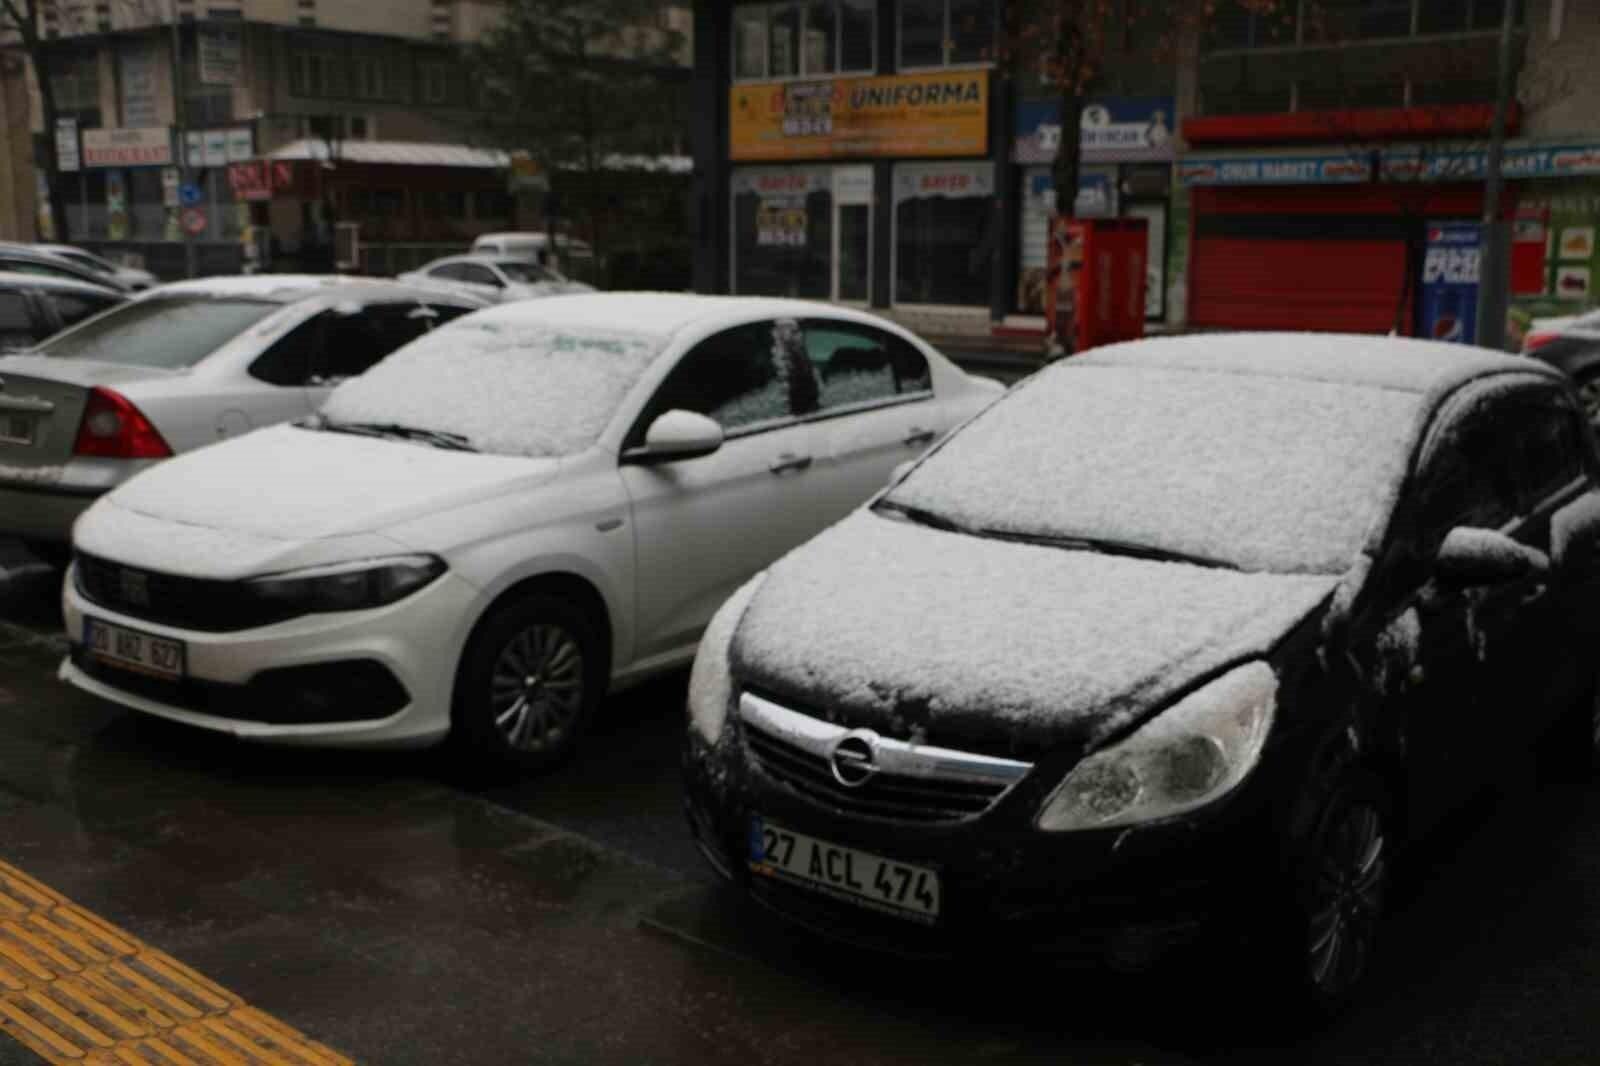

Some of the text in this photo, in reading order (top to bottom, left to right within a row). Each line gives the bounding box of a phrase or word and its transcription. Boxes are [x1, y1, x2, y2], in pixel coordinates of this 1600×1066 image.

[763, 828, 797, 868] 27
[808, 843, 864, 891] ACL
[873, 861, 935, 909] 474
